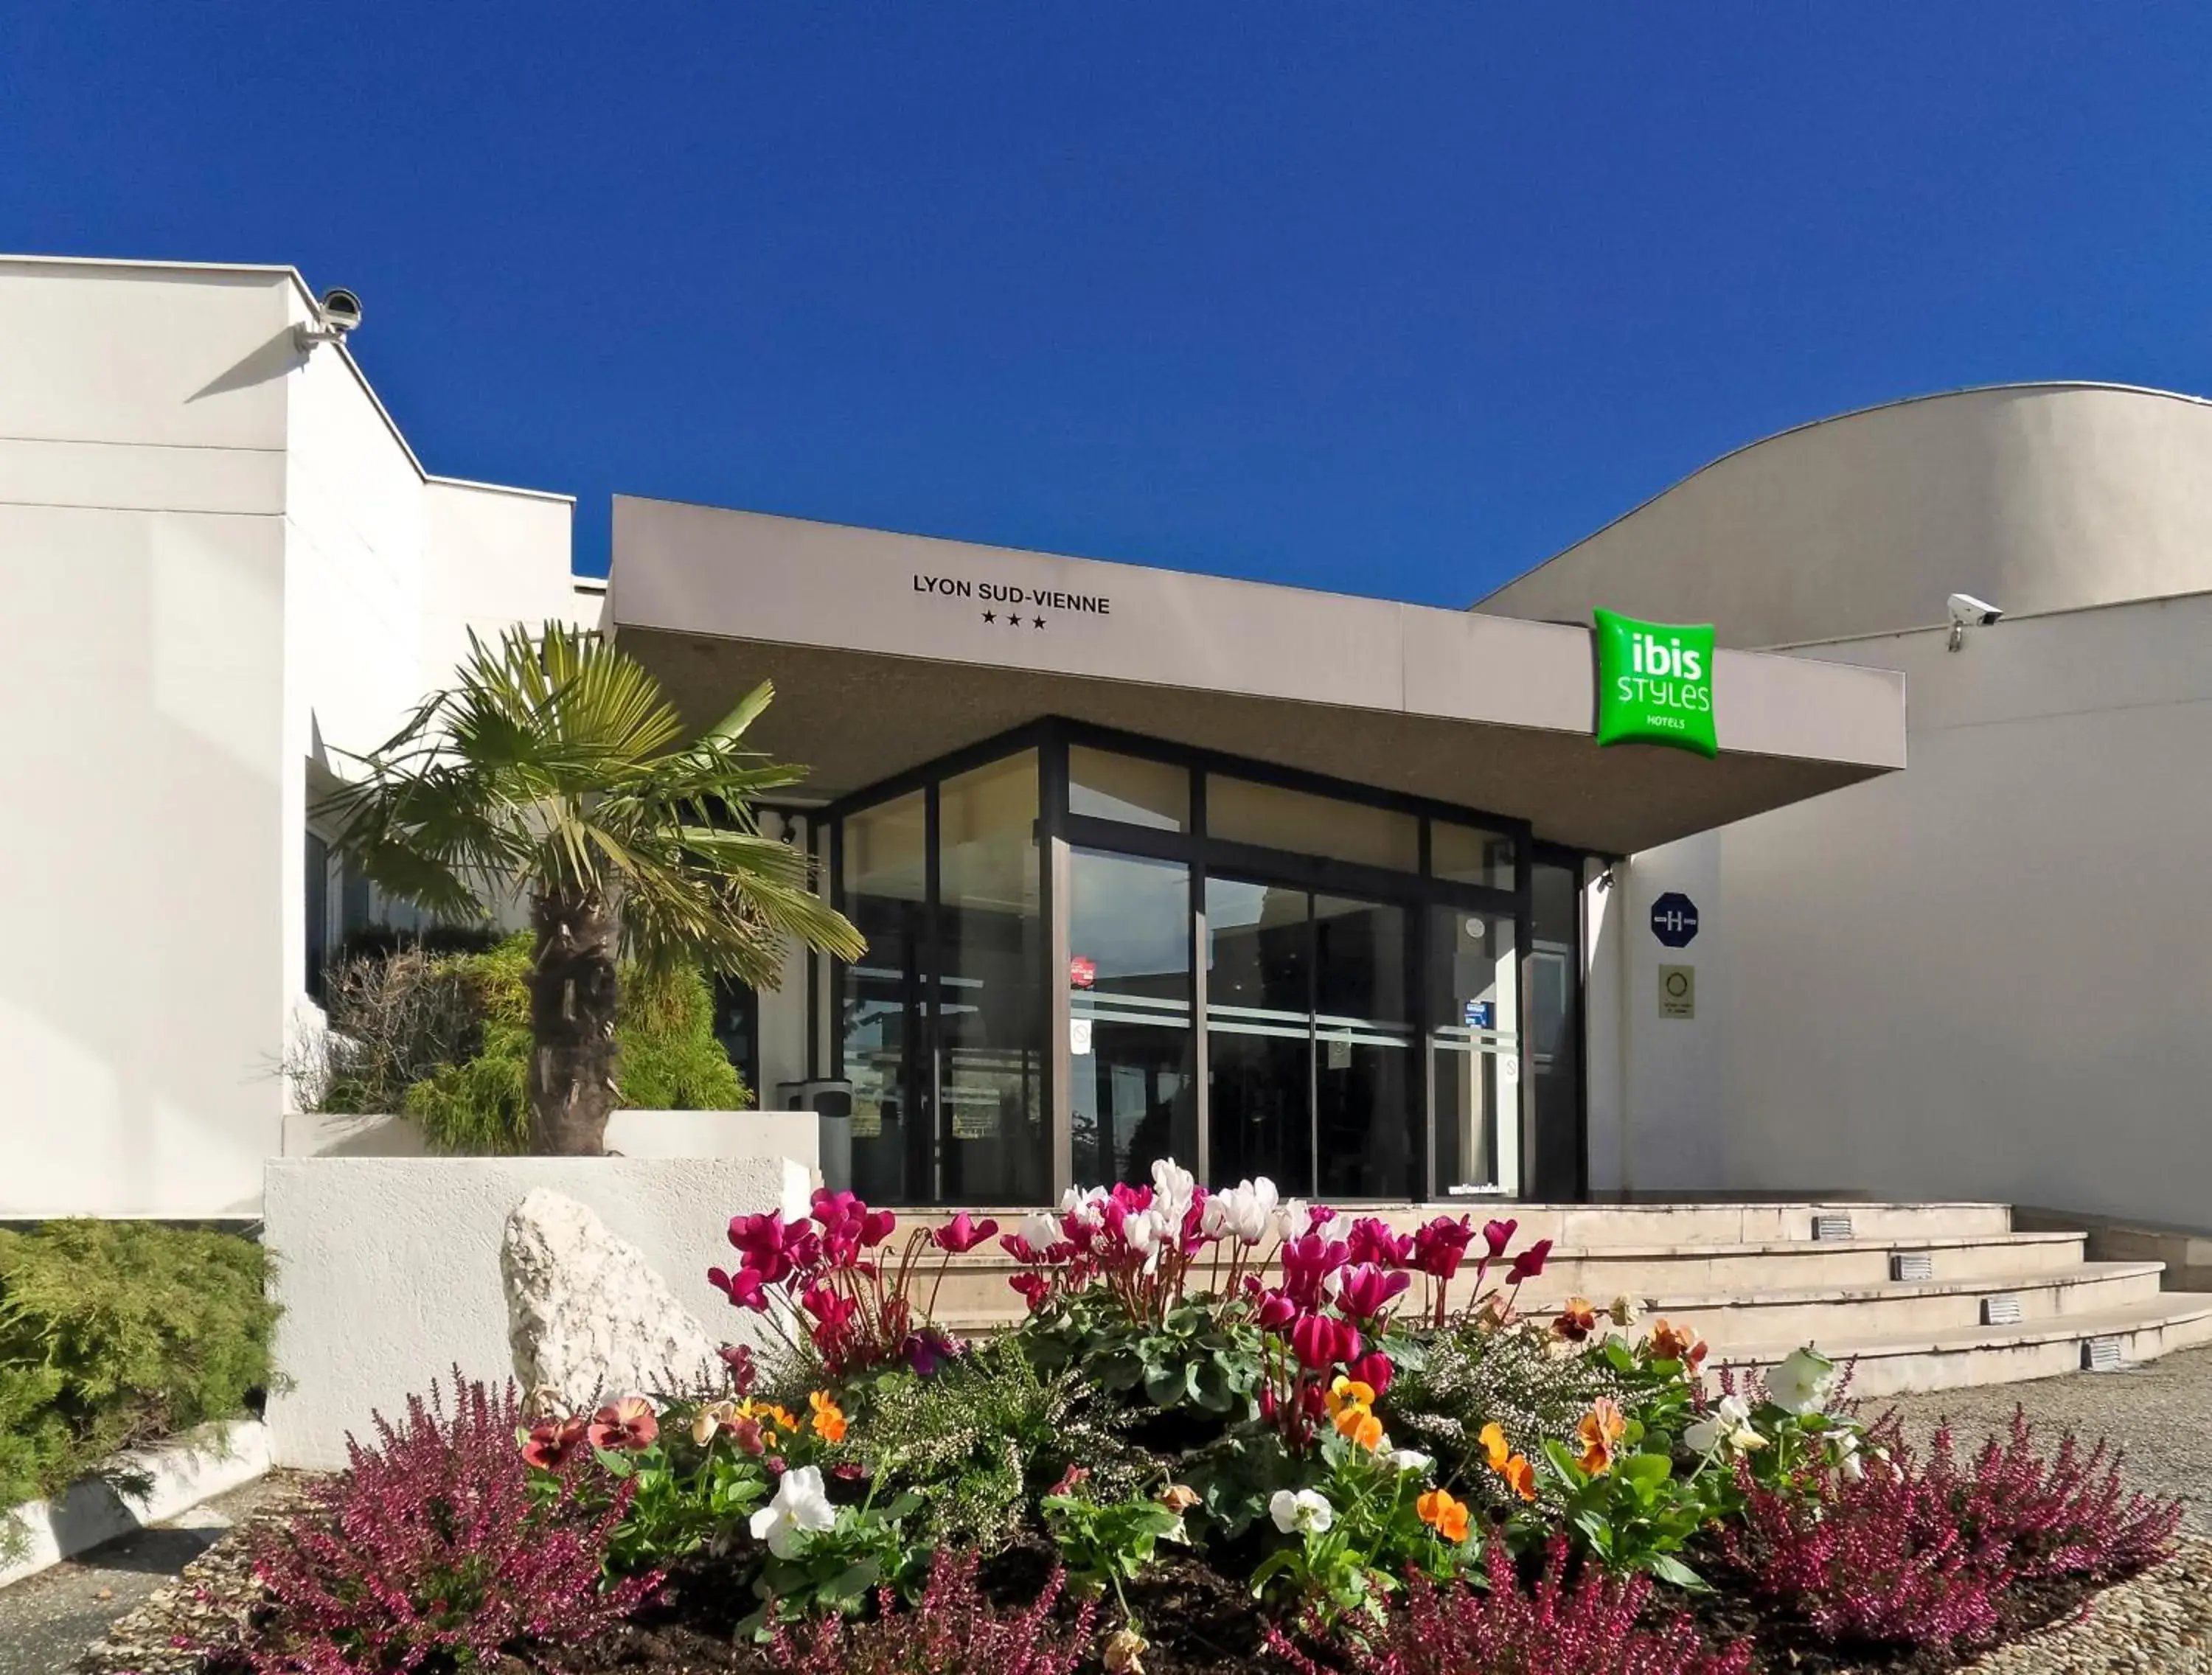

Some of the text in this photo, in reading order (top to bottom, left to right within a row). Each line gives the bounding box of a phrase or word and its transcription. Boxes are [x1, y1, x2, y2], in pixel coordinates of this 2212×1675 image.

[914, 575, 1110, 614] LYON SUD-VIENNE
[1632, 633, 1702, 680] ibis
[1647, 714, 1686, 729] HOTELS
